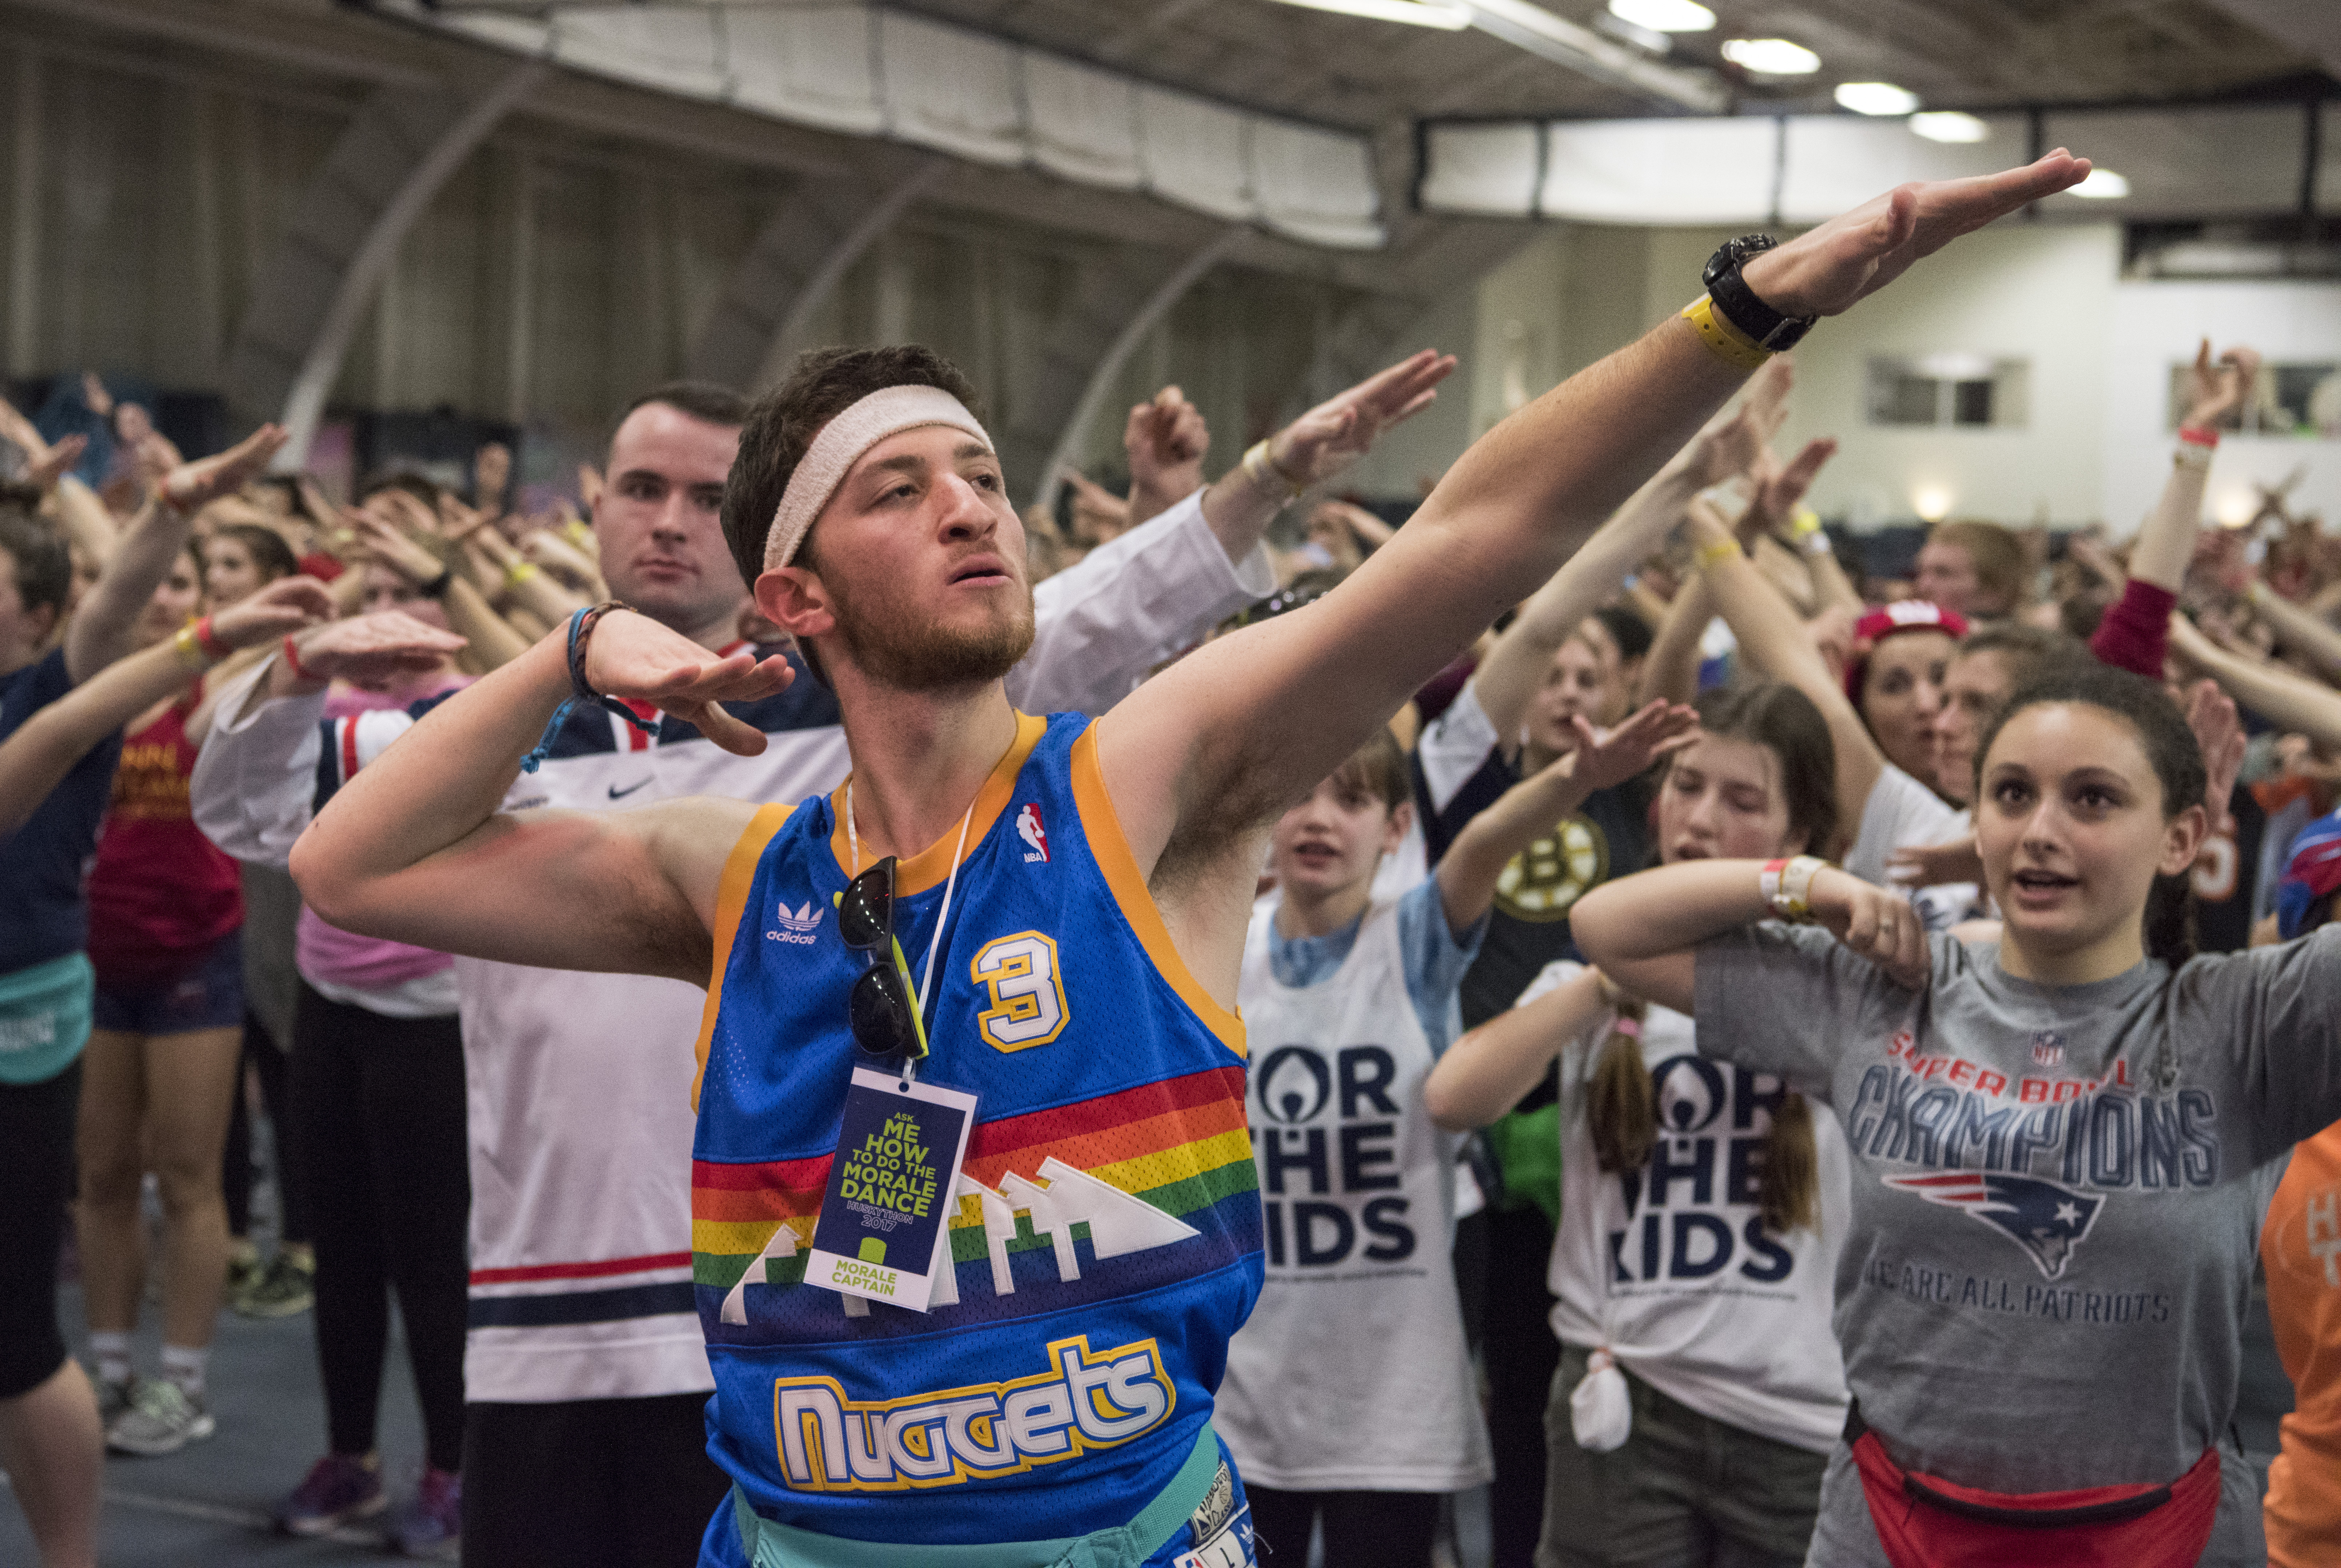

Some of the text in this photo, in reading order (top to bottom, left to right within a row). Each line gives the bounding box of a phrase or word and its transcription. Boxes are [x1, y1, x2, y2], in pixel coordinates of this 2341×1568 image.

[1024, 852, 1042, 863] NBA
[767, 930, 816, 945] adidas
[971, 930, 1070, 1053] 3
[1246, 1045, 1401, 1124] OR
[1887, 1034, 2135, 1103] SUPER BOL
[1651, 1053, 1787, 1131] OR
[883, 1118, 920, 1144] ME
[894, 1112, 913, 1123] ASK
[1849, 1064, 2221, 1191] CHAMPIONS
[853, 1149, 936, 1180] TO DO THE
[865, 1133, 929, 1164] HOW
[1249, 1122, 1401, 1195] HE
[843, 1161, 937, 1198] MORALE
[1649, 1138, 1775, 1206] HE
[840, 1178, 931, 1217] DANCE
[847, 1200, 914, 1224] HUSKYTHON
[861, 1215, 897, 1232] 2017
[1265, 1196, 1418, 1268] IDS
[832, 1272, 895, 1296] CAPTAIN
[836, 1260, 897, 1284] MORALE
[1901, 1264, 1953, 1302] ARE
[1963, 1276, 2016, 1312] ALL
[2025, 1285, 2170, 1322] PATRIOTS
[775, 1334, 1176, 1492] Nuggets
